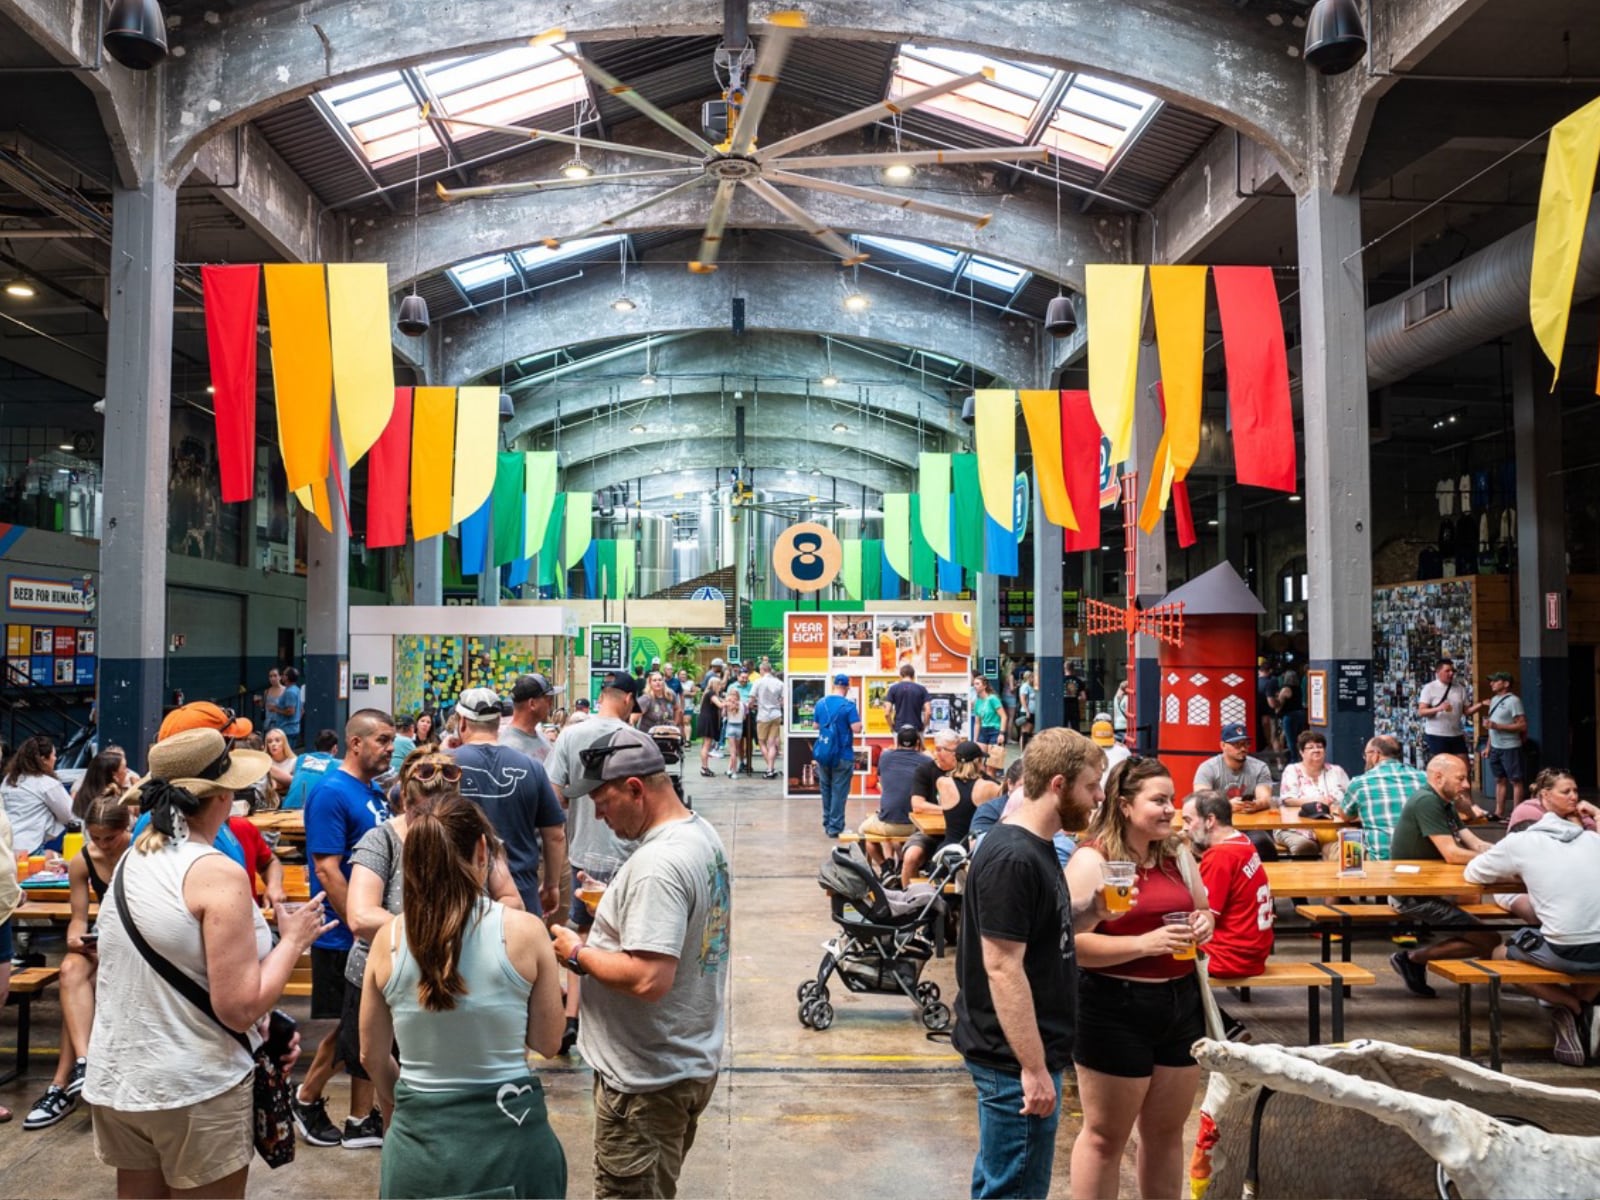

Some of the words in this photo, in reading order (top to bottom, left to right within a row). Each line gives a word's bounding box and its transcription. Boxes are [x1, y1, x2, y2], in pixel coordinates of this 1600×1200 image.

[791, 532, 824, 580] 8
[14, 587, 33, 601] BEER
[35, 589, 50, 602] FOR
[51, 590, 79, 604] HUMANS
[793, 622, 823, 632] YEAR
[792, 632, 824, 643] EIGHT
